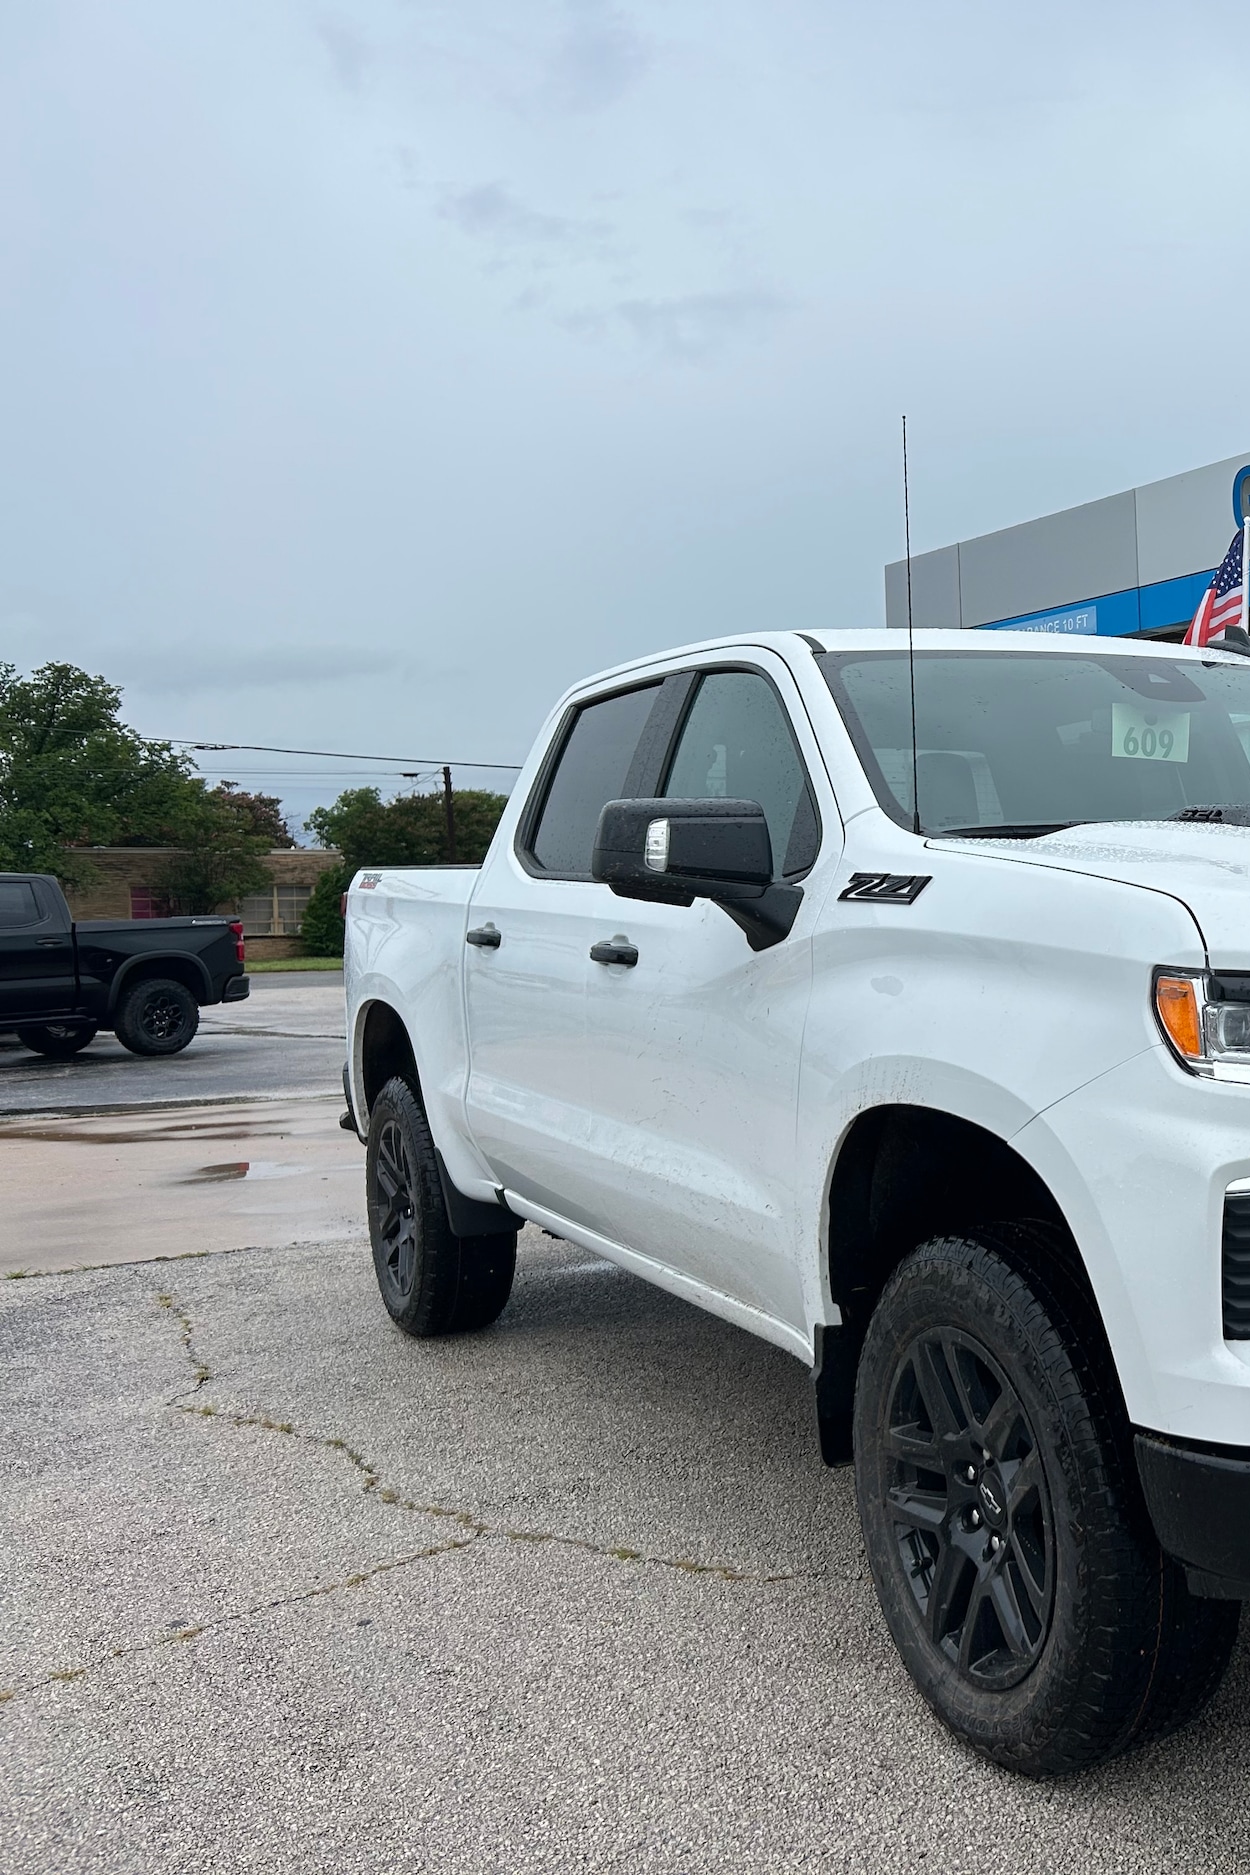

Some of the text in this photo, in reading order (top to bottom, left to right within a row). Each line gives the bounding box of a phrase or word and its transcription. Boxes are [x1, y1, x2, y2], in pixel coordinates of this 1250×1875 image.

[1062, 619, 1074, 632] 10
[1076, 614, 1088, 629] FT
[1123, 726, 1174, 759] 609
[837, 872, 933, 905] Z71
